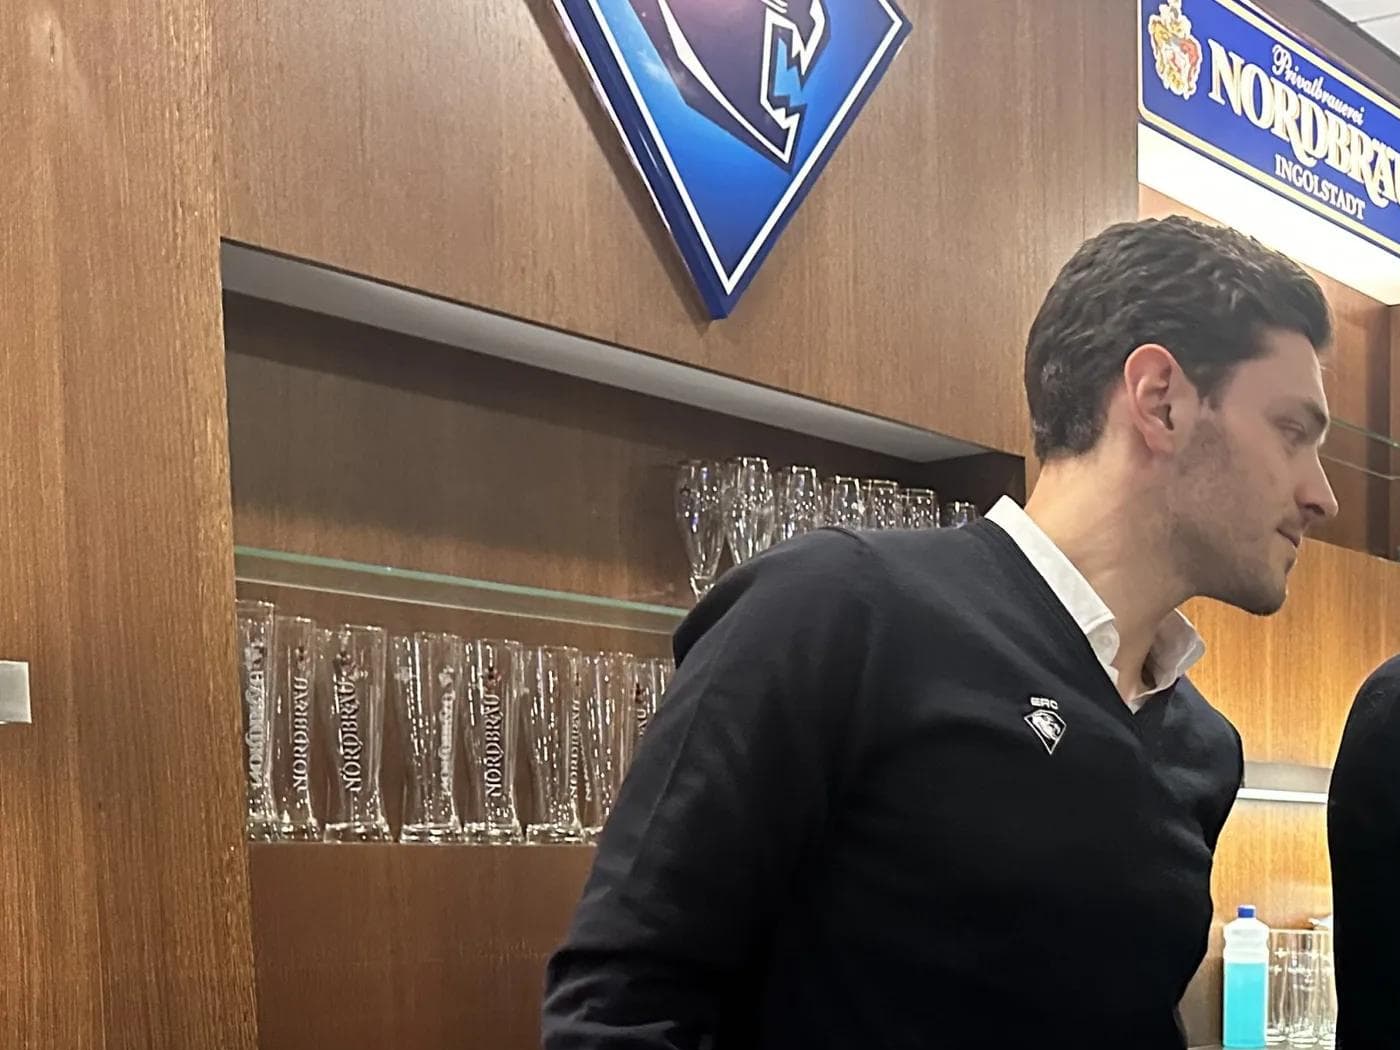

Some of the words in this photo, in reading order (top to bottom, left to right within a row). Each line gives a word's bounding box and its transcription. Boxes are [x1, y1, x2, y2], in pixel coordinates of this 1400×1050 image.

[1271, 43, 1365, 127] Privatbrauerei
[1273, 152, 1367, 221] INGOLSTADT
[1030, 696, 1059, 710] ERC
